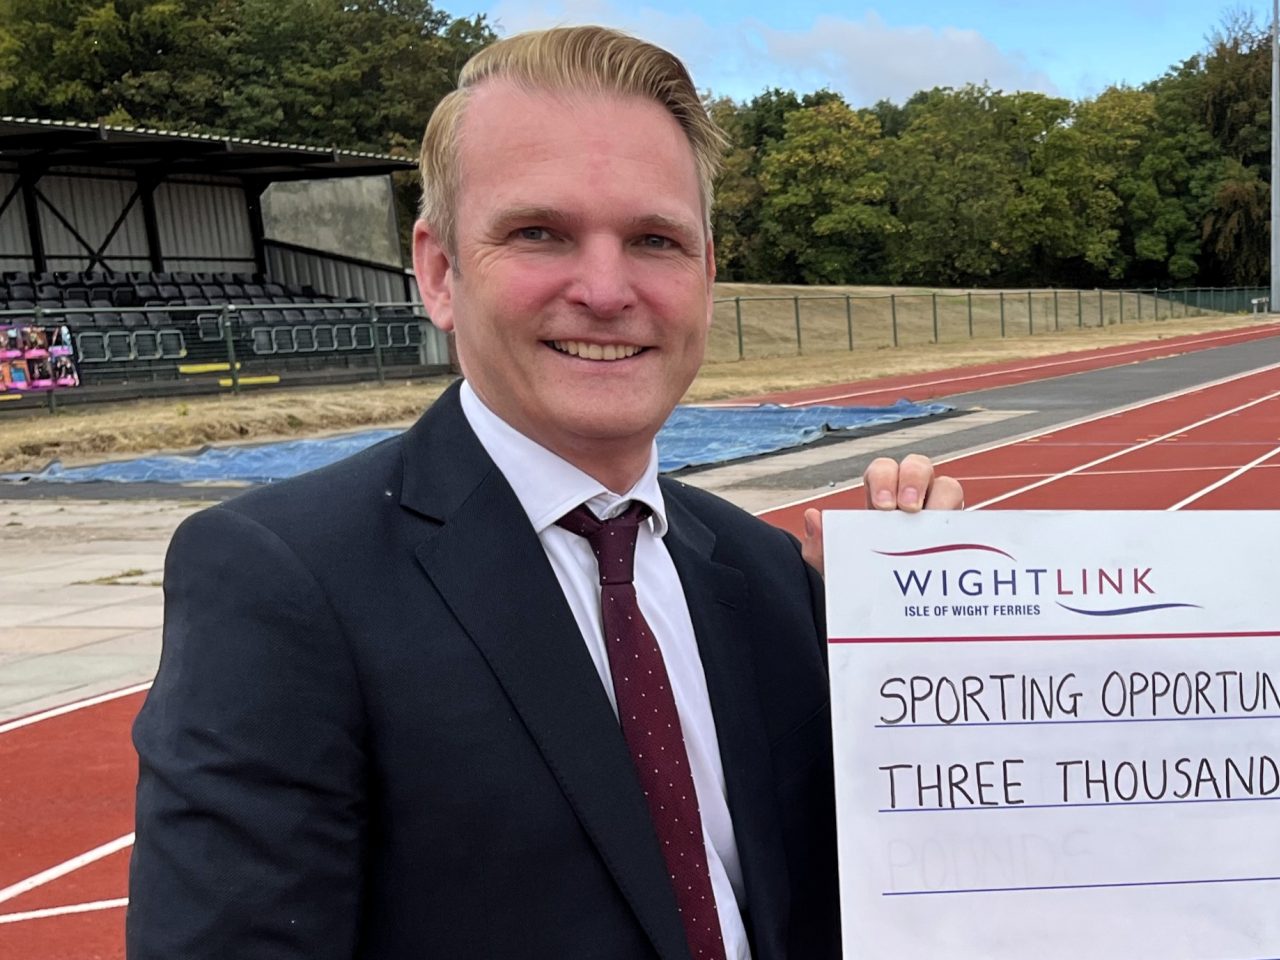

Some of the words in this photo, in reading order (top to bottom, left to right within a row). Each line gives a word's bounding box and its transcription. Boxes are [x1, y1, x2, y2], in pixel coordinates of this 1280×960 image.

[893, 567, 1156, 597] WIGHTLINK
[904, 606, 929, 617] ISLE
[934, 606, 949, 616] OF
[952, 605, 988, 616] WIGHT
[993, 604, 1041, 616] FERRIES
[879, 673, 1083, 725] SPORTING
[878, 759, 1024, 809] THREE
[1056, 755, 1280, 802] THOUSAND
